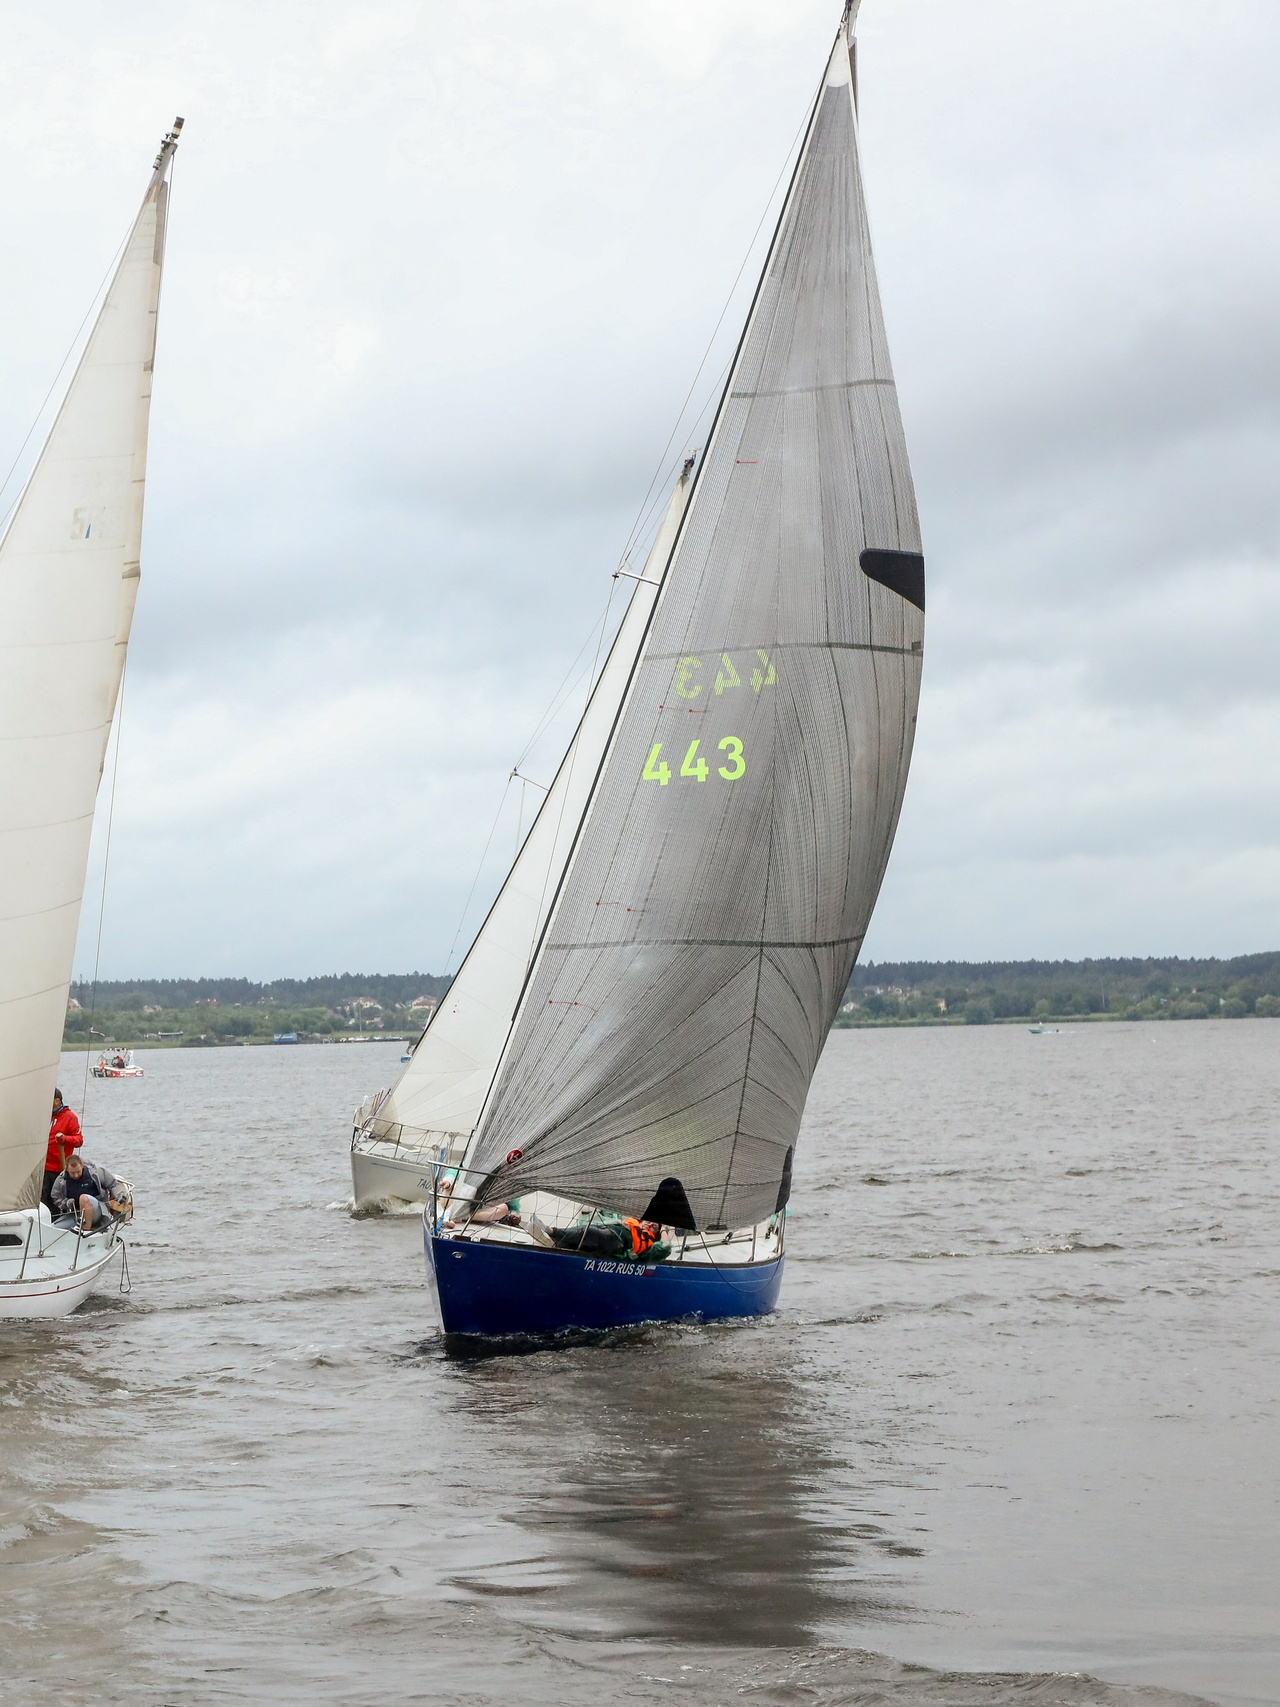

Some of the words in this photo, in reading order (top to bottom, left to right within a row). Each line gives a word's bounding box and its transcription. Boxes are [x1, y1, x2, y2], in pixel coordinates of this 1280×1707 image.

[642, 736, 746, 786] 443
[584, 1259, 596, 1271] TA
[597, 1261, 617, 1273] 1022
[615, 1263, 635, 1275] RUS
[634, 1265, 646, 1276] 50
